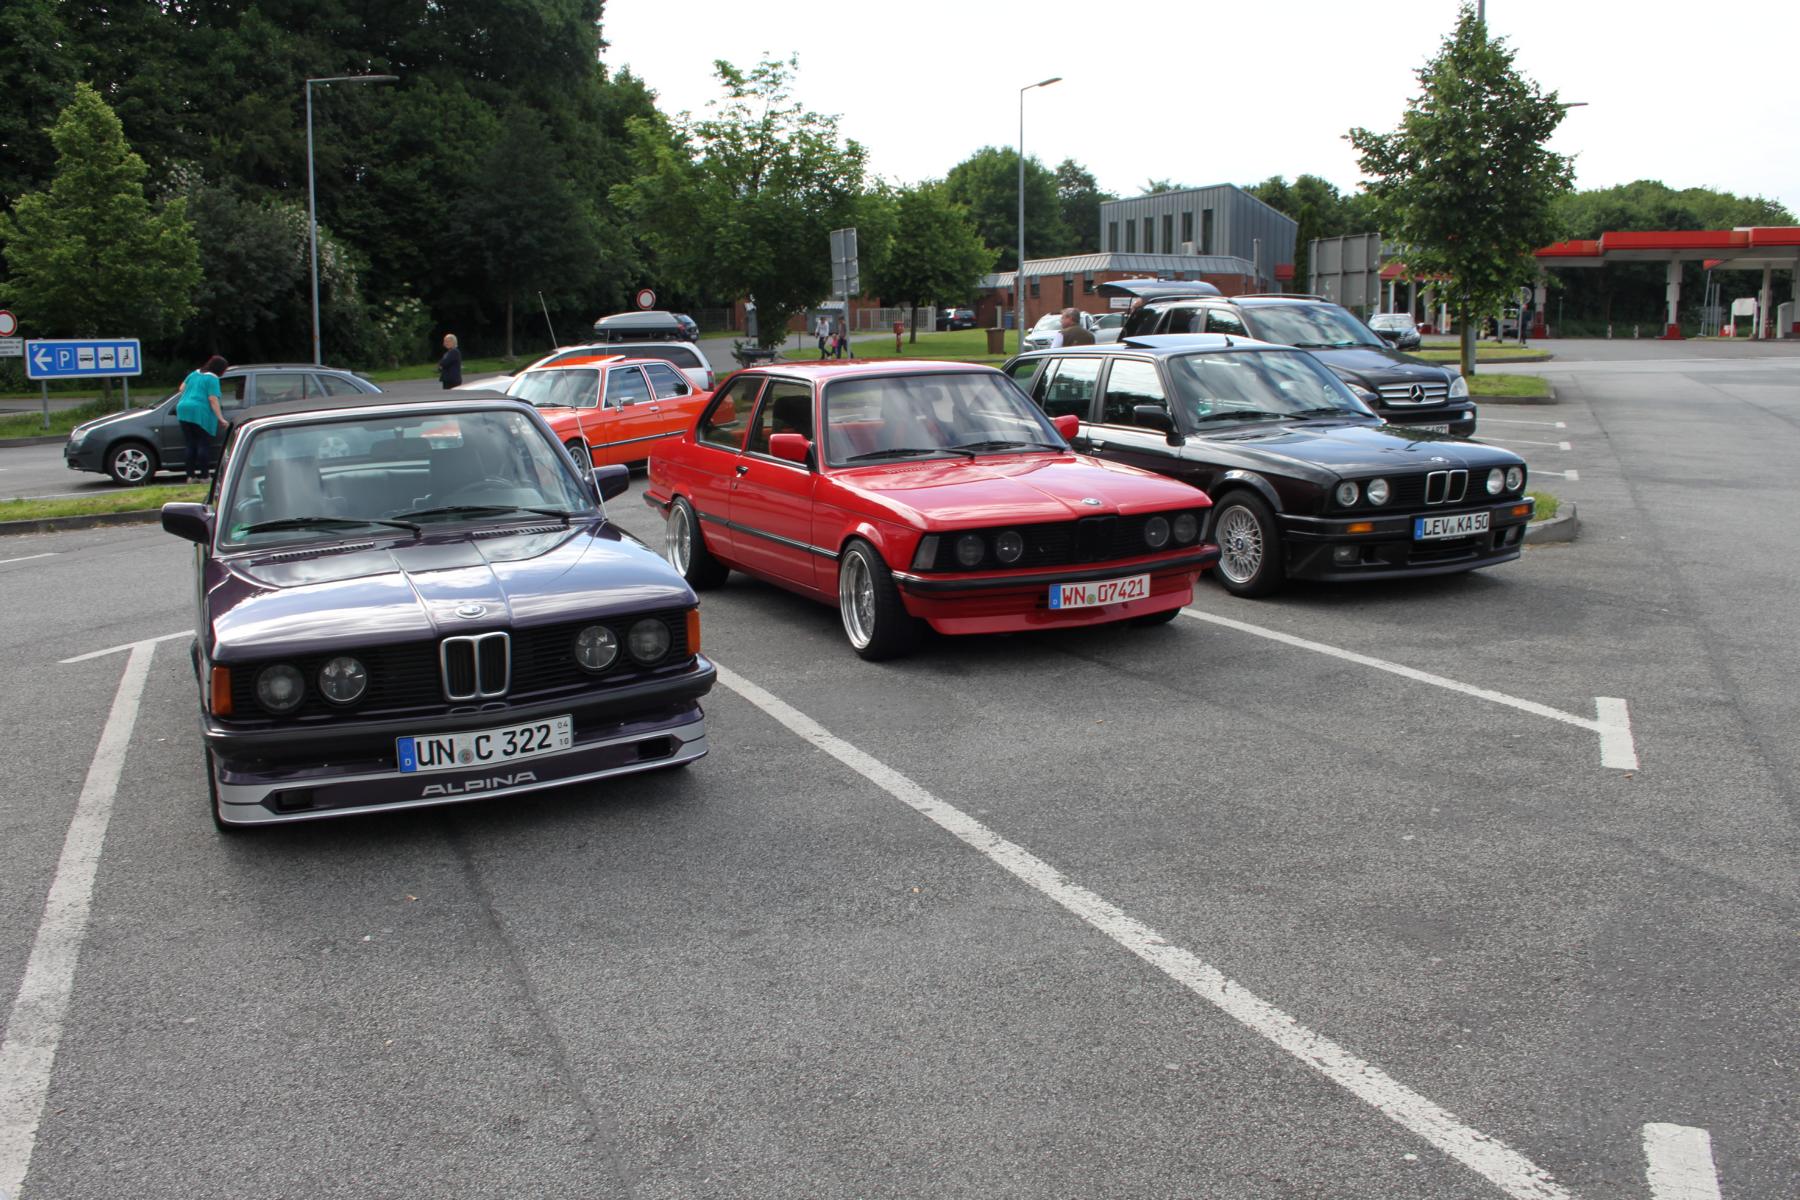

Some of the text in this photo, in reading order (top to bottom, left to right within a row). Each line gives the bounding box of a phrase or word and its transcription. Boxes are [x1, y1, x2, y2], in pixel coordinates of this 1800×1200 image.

[60, 350, 70, 368] P
[1424, 514, 1488, 536] LEV KA 50
[1062, 586, 1086, 606] WN
[1097, 578, 1145, 602] 07421
[557, 720, 569, 730] 04
[404, 724, 552, 767] D UN C 322
[558, 737, 570, 747] 10
[421, 771, 537, 796] ALPINA
